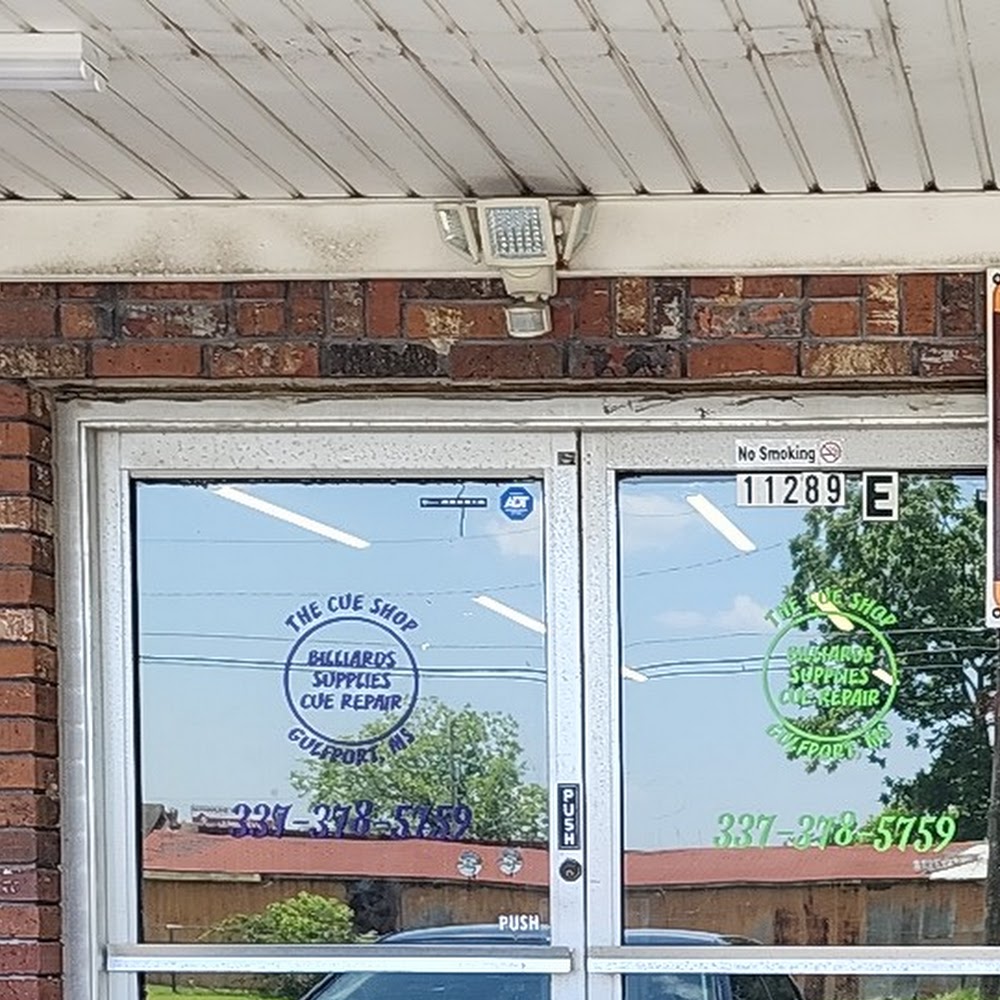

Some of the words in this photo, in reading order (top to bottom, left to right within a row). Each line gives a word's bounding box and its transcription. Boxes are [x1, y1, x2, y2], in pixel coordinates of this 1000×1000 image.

[738, 446, 755, 461] No
[759, 445, 816, 464] Smoking
[503, 496, 530, 508] ADT
[743, 474, 841, 504] 11289
[866, 475, 893, 517] E
[285, 601, 322, 632] THE
[327, 593, 365, 612] CUE
[369, 598, 418, 632] SHOP
[765, 595, 802, 627] THE
[850, 593, 898, 626] SHOP
[307, 650, 397, 668] BILLIARDS
[312, 671, 391, 689] SUPPLIES
[790, 667, 870, 685] SUPPLIES
[300, 693, 335, 710] CUE
[340, 693, 403, 710] REPAIR
[819, 689, 880, 706] REPAIR
[388, 728, 415, 753] MS
[863, 721, 892, 748] MS
[229, 800, 473, 840] 337-378-5759
[563, 789, 575, 845] PUSH
[712, 811, 957, 852] 337-378-5759
[498, 915, 540, 931] PUSH
